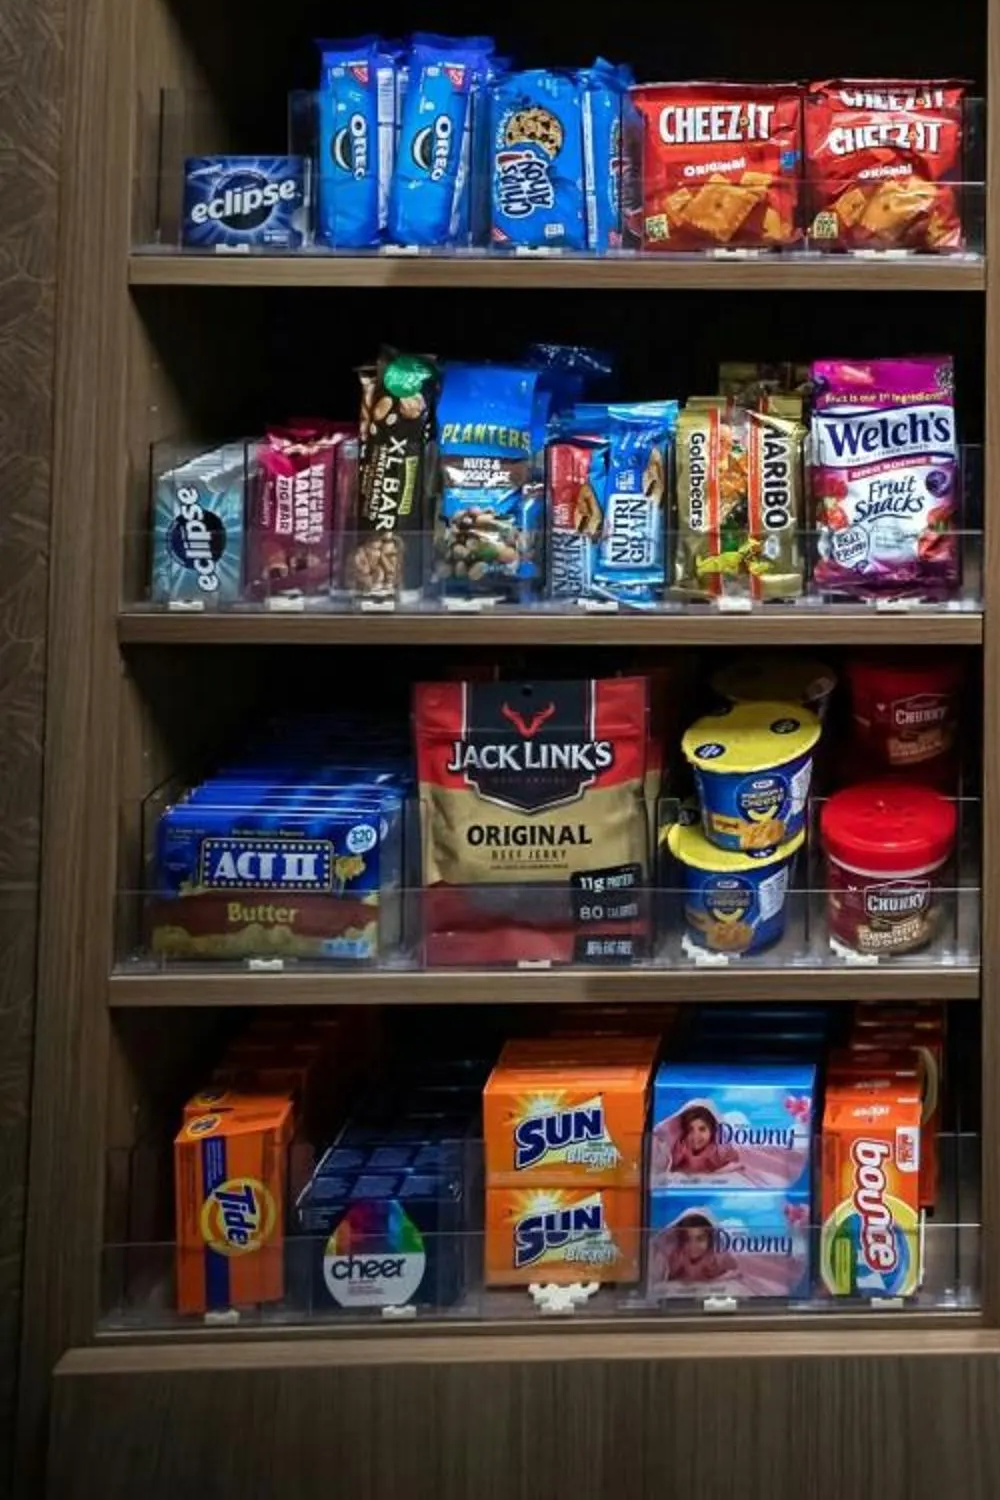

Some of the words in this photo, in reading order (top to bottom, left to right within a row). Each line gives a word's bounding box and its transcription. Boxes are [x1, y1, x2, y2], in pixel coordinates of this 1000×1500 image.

[351, 113, 367, 181] OREO
[431, 115, 451, 181] OREO
[191, 179, 296, 223] eclipse
[441, 423, 531, 449] PLANTERS
[824, 411, 951, 457] Welch's
[385, 436, 408, 469] XL
[463, 458, 491, 470] NUTS
[492, 459, 501, 470] &
[690, 432, 706, 528] Goldbears
[869, 475, 917, 502] Fruit
[376, 476, 400, 531] BAR
[853, 494, 926, 523] Snacks
[177, 485, 218, 592] eclipse
[611, 499, 629, 563] NUTRI
[630, 499, 647, 563] GRAIN
[448, 741, 522, 773] JACK
[524, 740, 612, 771] LINK'S
[467, 825, 592, 847] ORIGINAL
[213, 851, 277, 880] ACT
[282, 852, 317, 881] II
[491, 850, 521, 861] BEEF
[528, 849, 567, 860] JERKY
[579, 876, 605, 893] 11g
[227, 902, 299, 923] Butter
[579, 906, 604, 920] 80
[867, 893, 925, 911] CHUNKY
[515, 1108, 603, 1168] SUN
[717, 1123, 795, 1150] Downy
[214, 1185, 257, 1245] Tide
[854, 1140, 896, 1270] bounce
[515, 1204, 603, 1267] SUN
[715, 1228, 793, 1257] Downy
[332, 1257, 406, 1280] cheer
